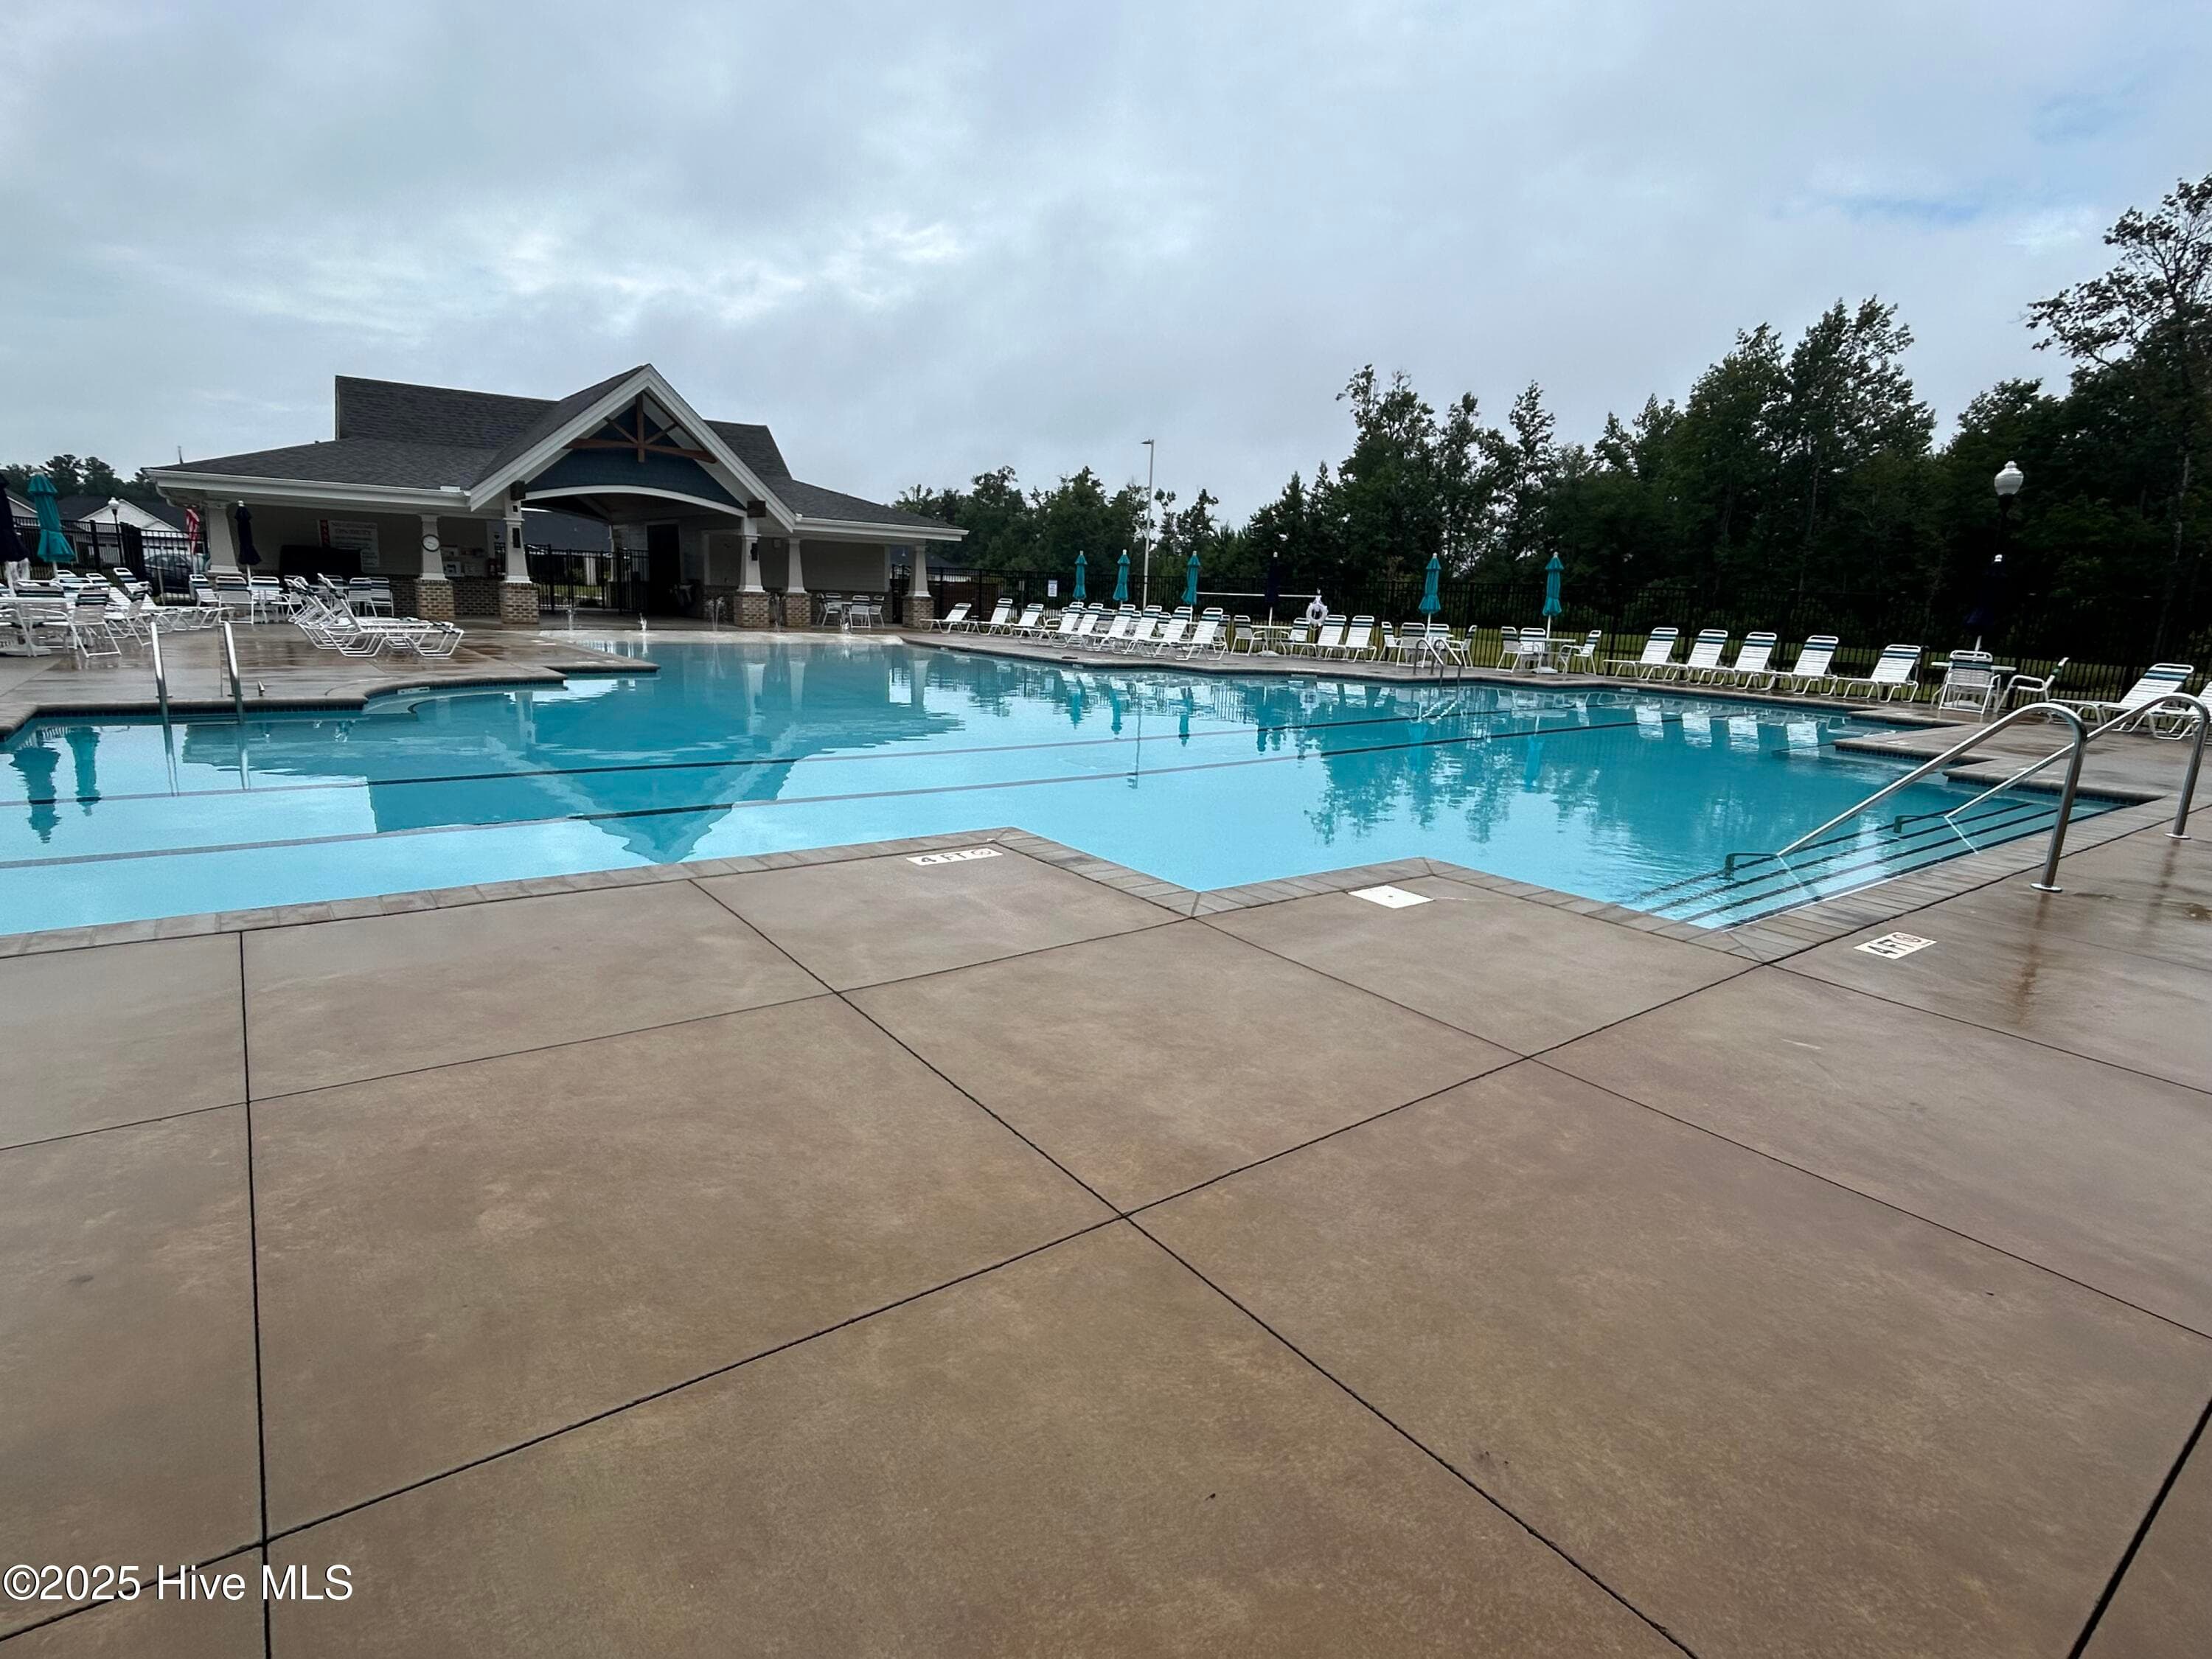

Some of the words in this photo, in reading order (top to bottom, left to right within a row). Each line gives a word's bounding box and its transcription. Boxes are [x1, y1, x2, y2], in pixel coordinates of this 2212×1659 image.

[939, 852, 967, 860] FT
[1867, 945, 1899, 955] 4
[1877, 939, 1915, 951] FT
